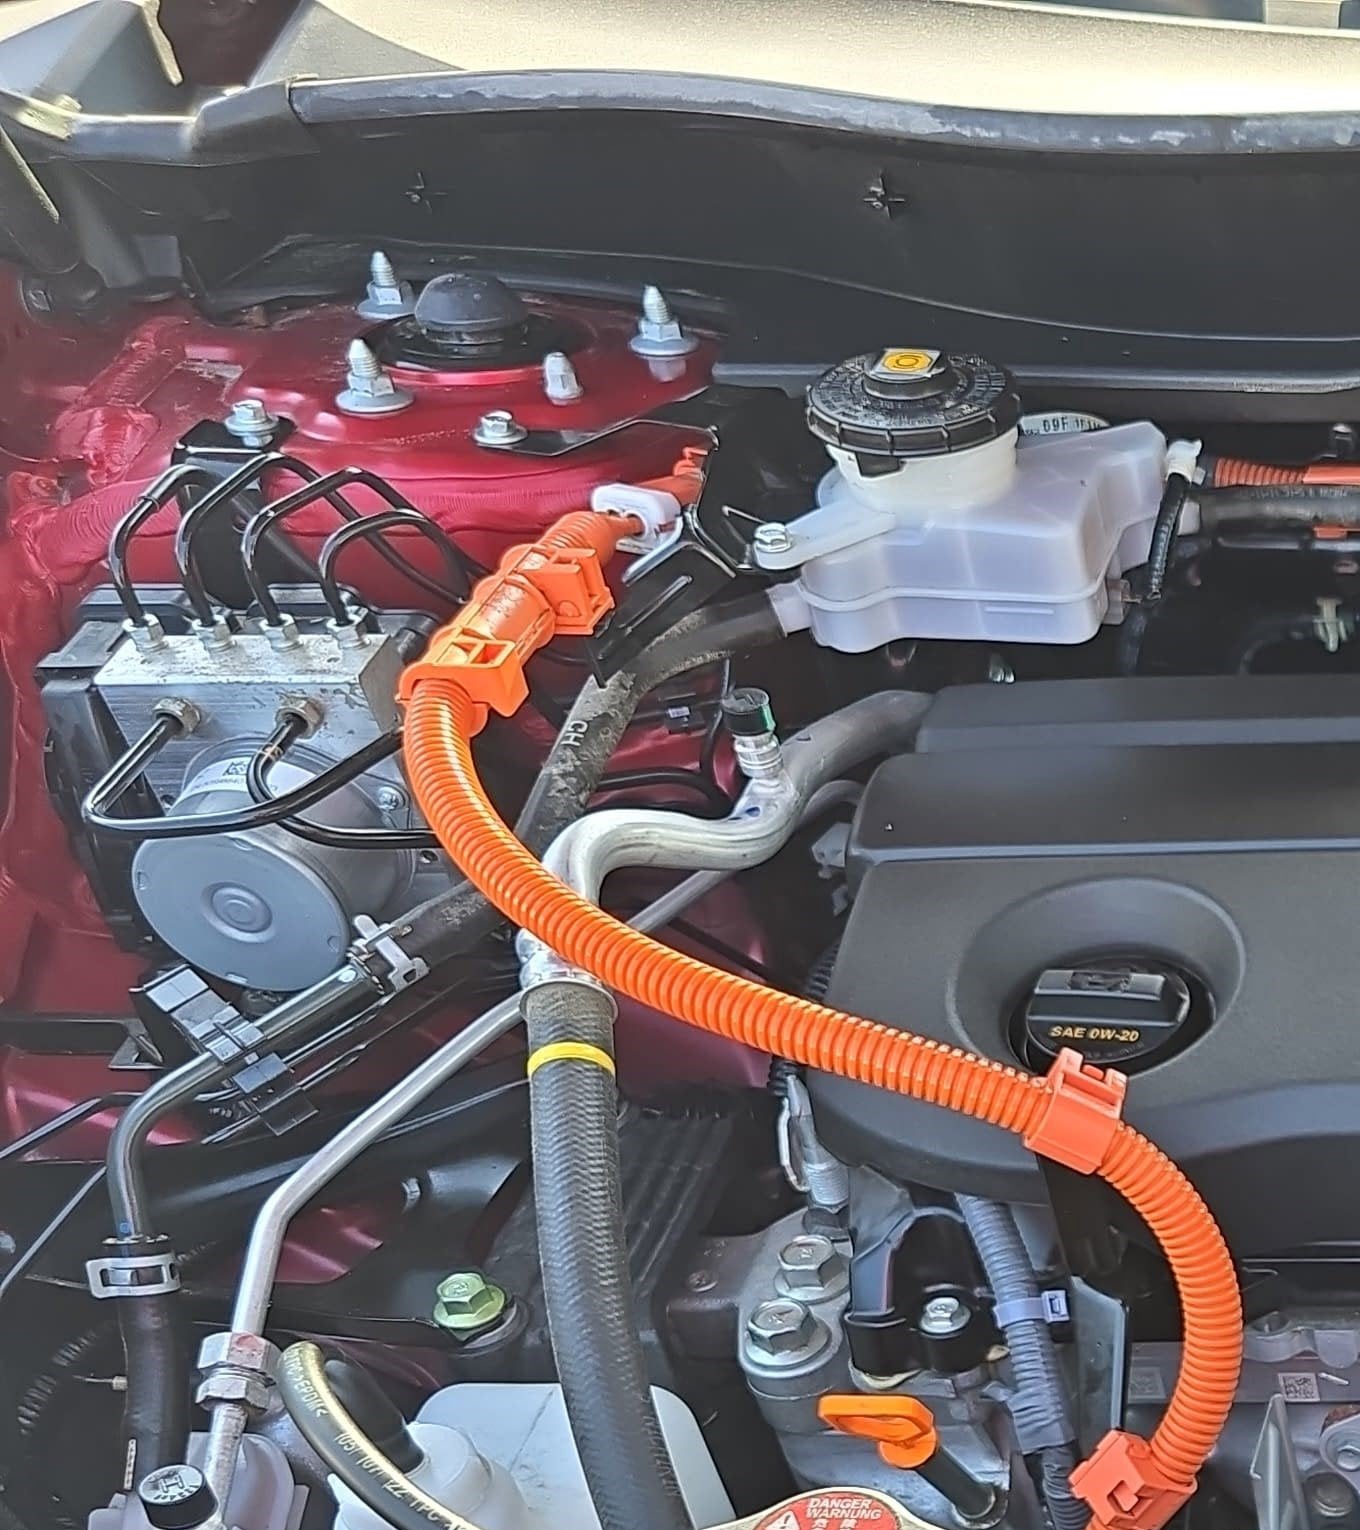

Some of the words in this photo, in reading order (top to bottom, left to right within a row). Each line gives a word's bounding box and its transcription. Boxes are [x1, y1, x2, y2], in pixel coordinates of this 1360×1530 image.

[1051, 1025, 1086, 1039] SAE
[1088, 1026, 1140, 1043] 0W-20
[808, 1498, 873, 1509] DANGER
[805, 1508, 882, 1520] WARNUNG
